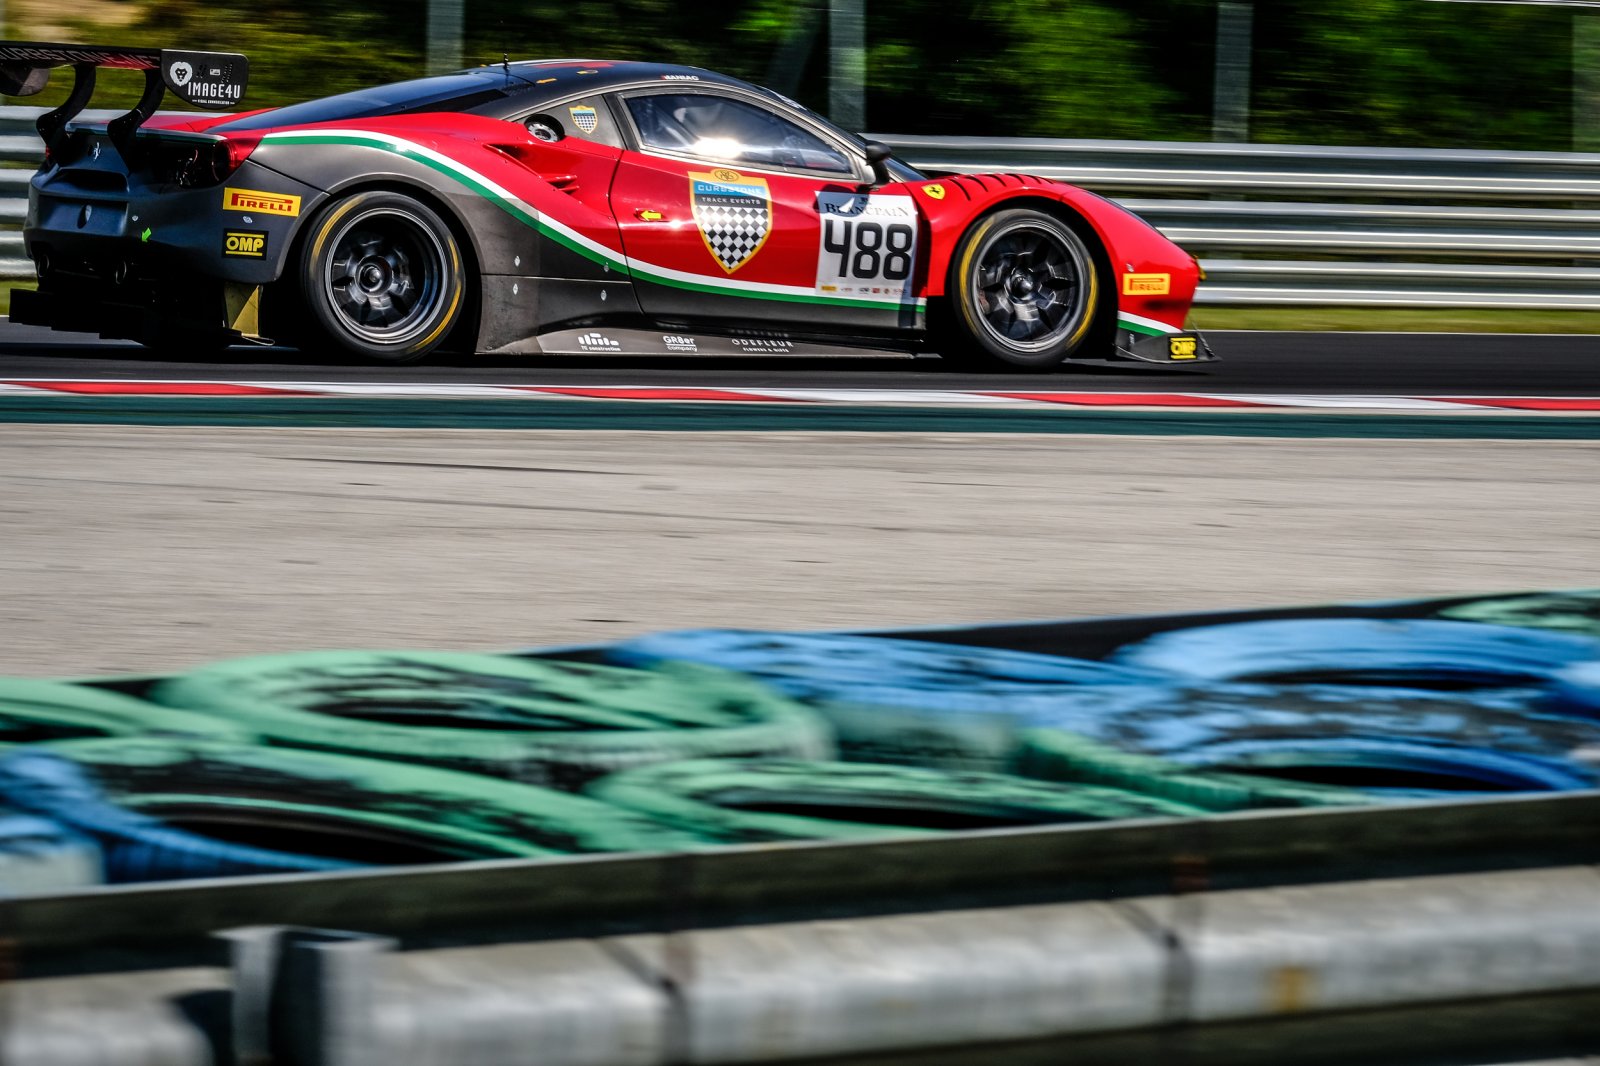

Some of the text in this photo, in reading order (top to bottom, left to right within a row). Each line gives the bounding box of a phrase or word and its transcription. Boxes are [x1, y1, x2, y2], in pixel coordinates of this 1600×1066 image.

[187, 81, 241, 99] IMAGE4U
[697, 184, 762, 194] CURBSTONE
[231, 193, 293, 212] PIRELLI
[226, 236, 264, 252] OMP
[824, 219, 913, 280] 488
[731, 338, 794, 347] ODEFLEUR
